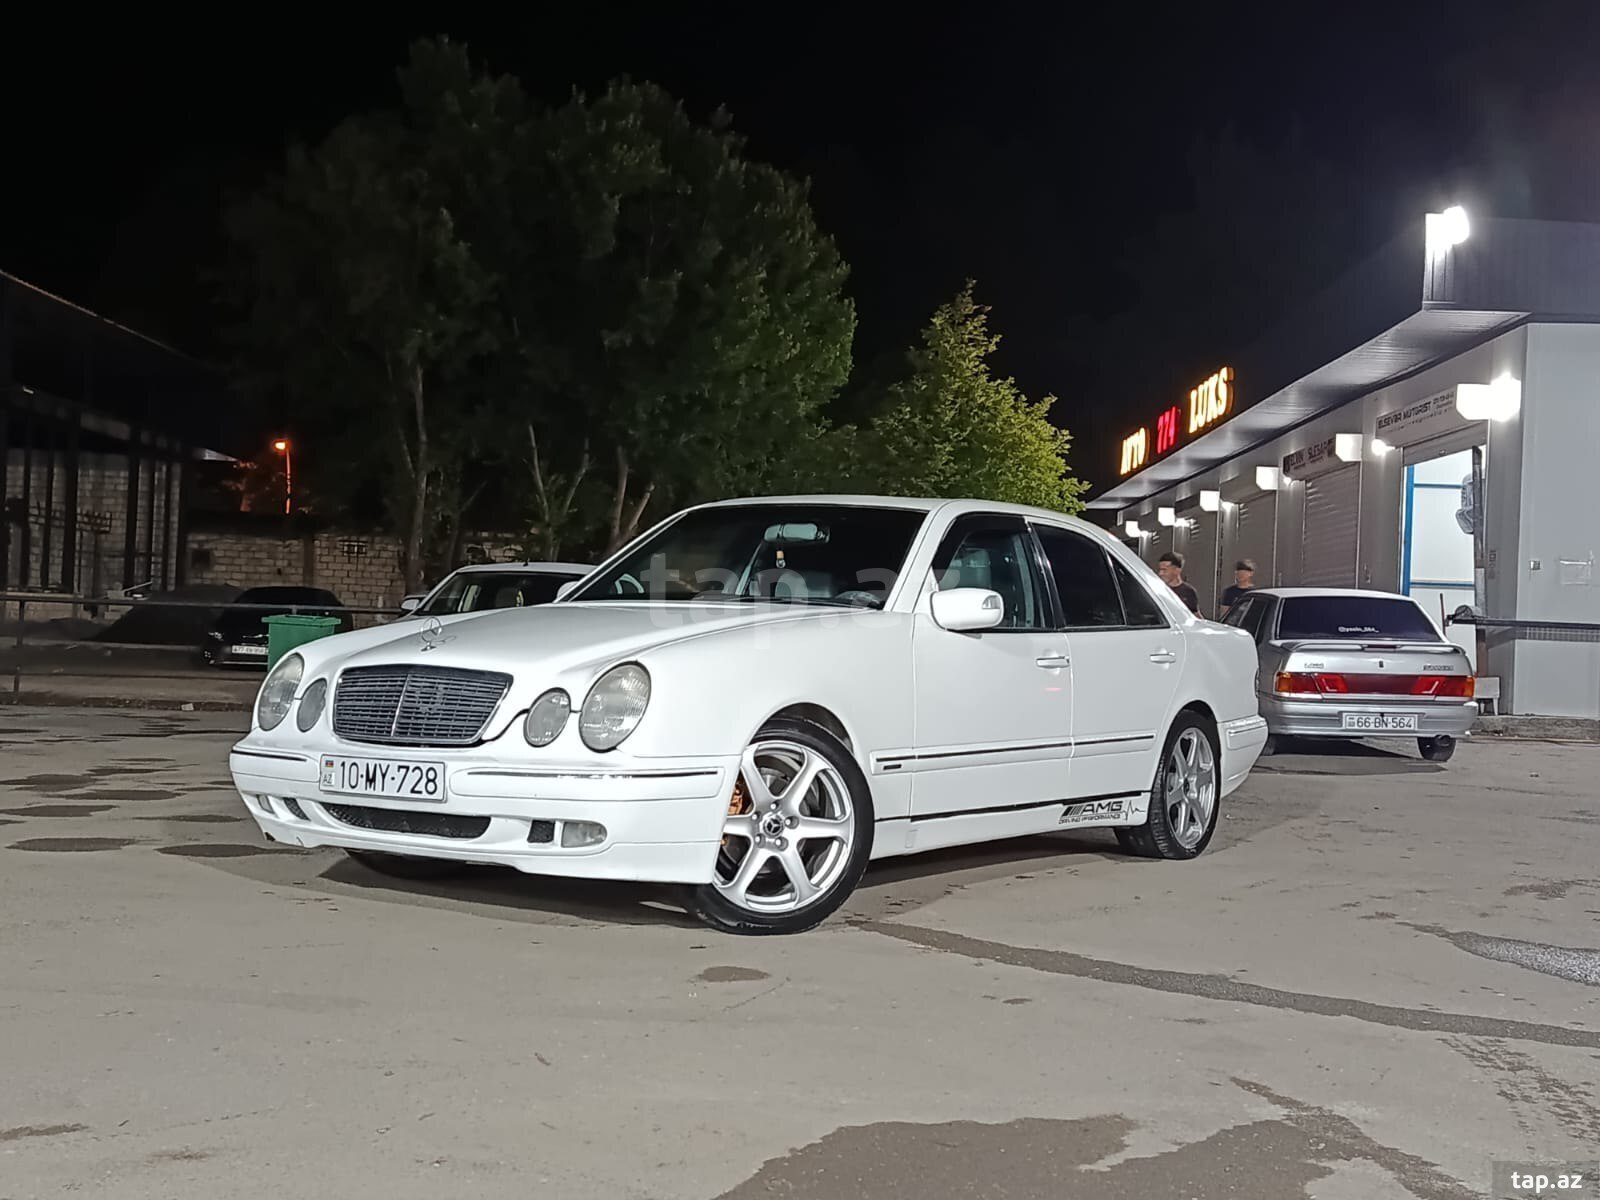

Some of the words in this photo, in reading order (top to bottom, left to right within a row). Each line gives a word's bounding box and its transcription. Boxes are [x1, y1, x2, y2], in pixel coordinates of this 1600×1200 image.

[1157, 406, 1177, 454] 774
[1189, 366, 1231, 434] LUKS
[340, 761, 438, 795] 10-MY-728
[1081, 801, 1123, 815] AMG
